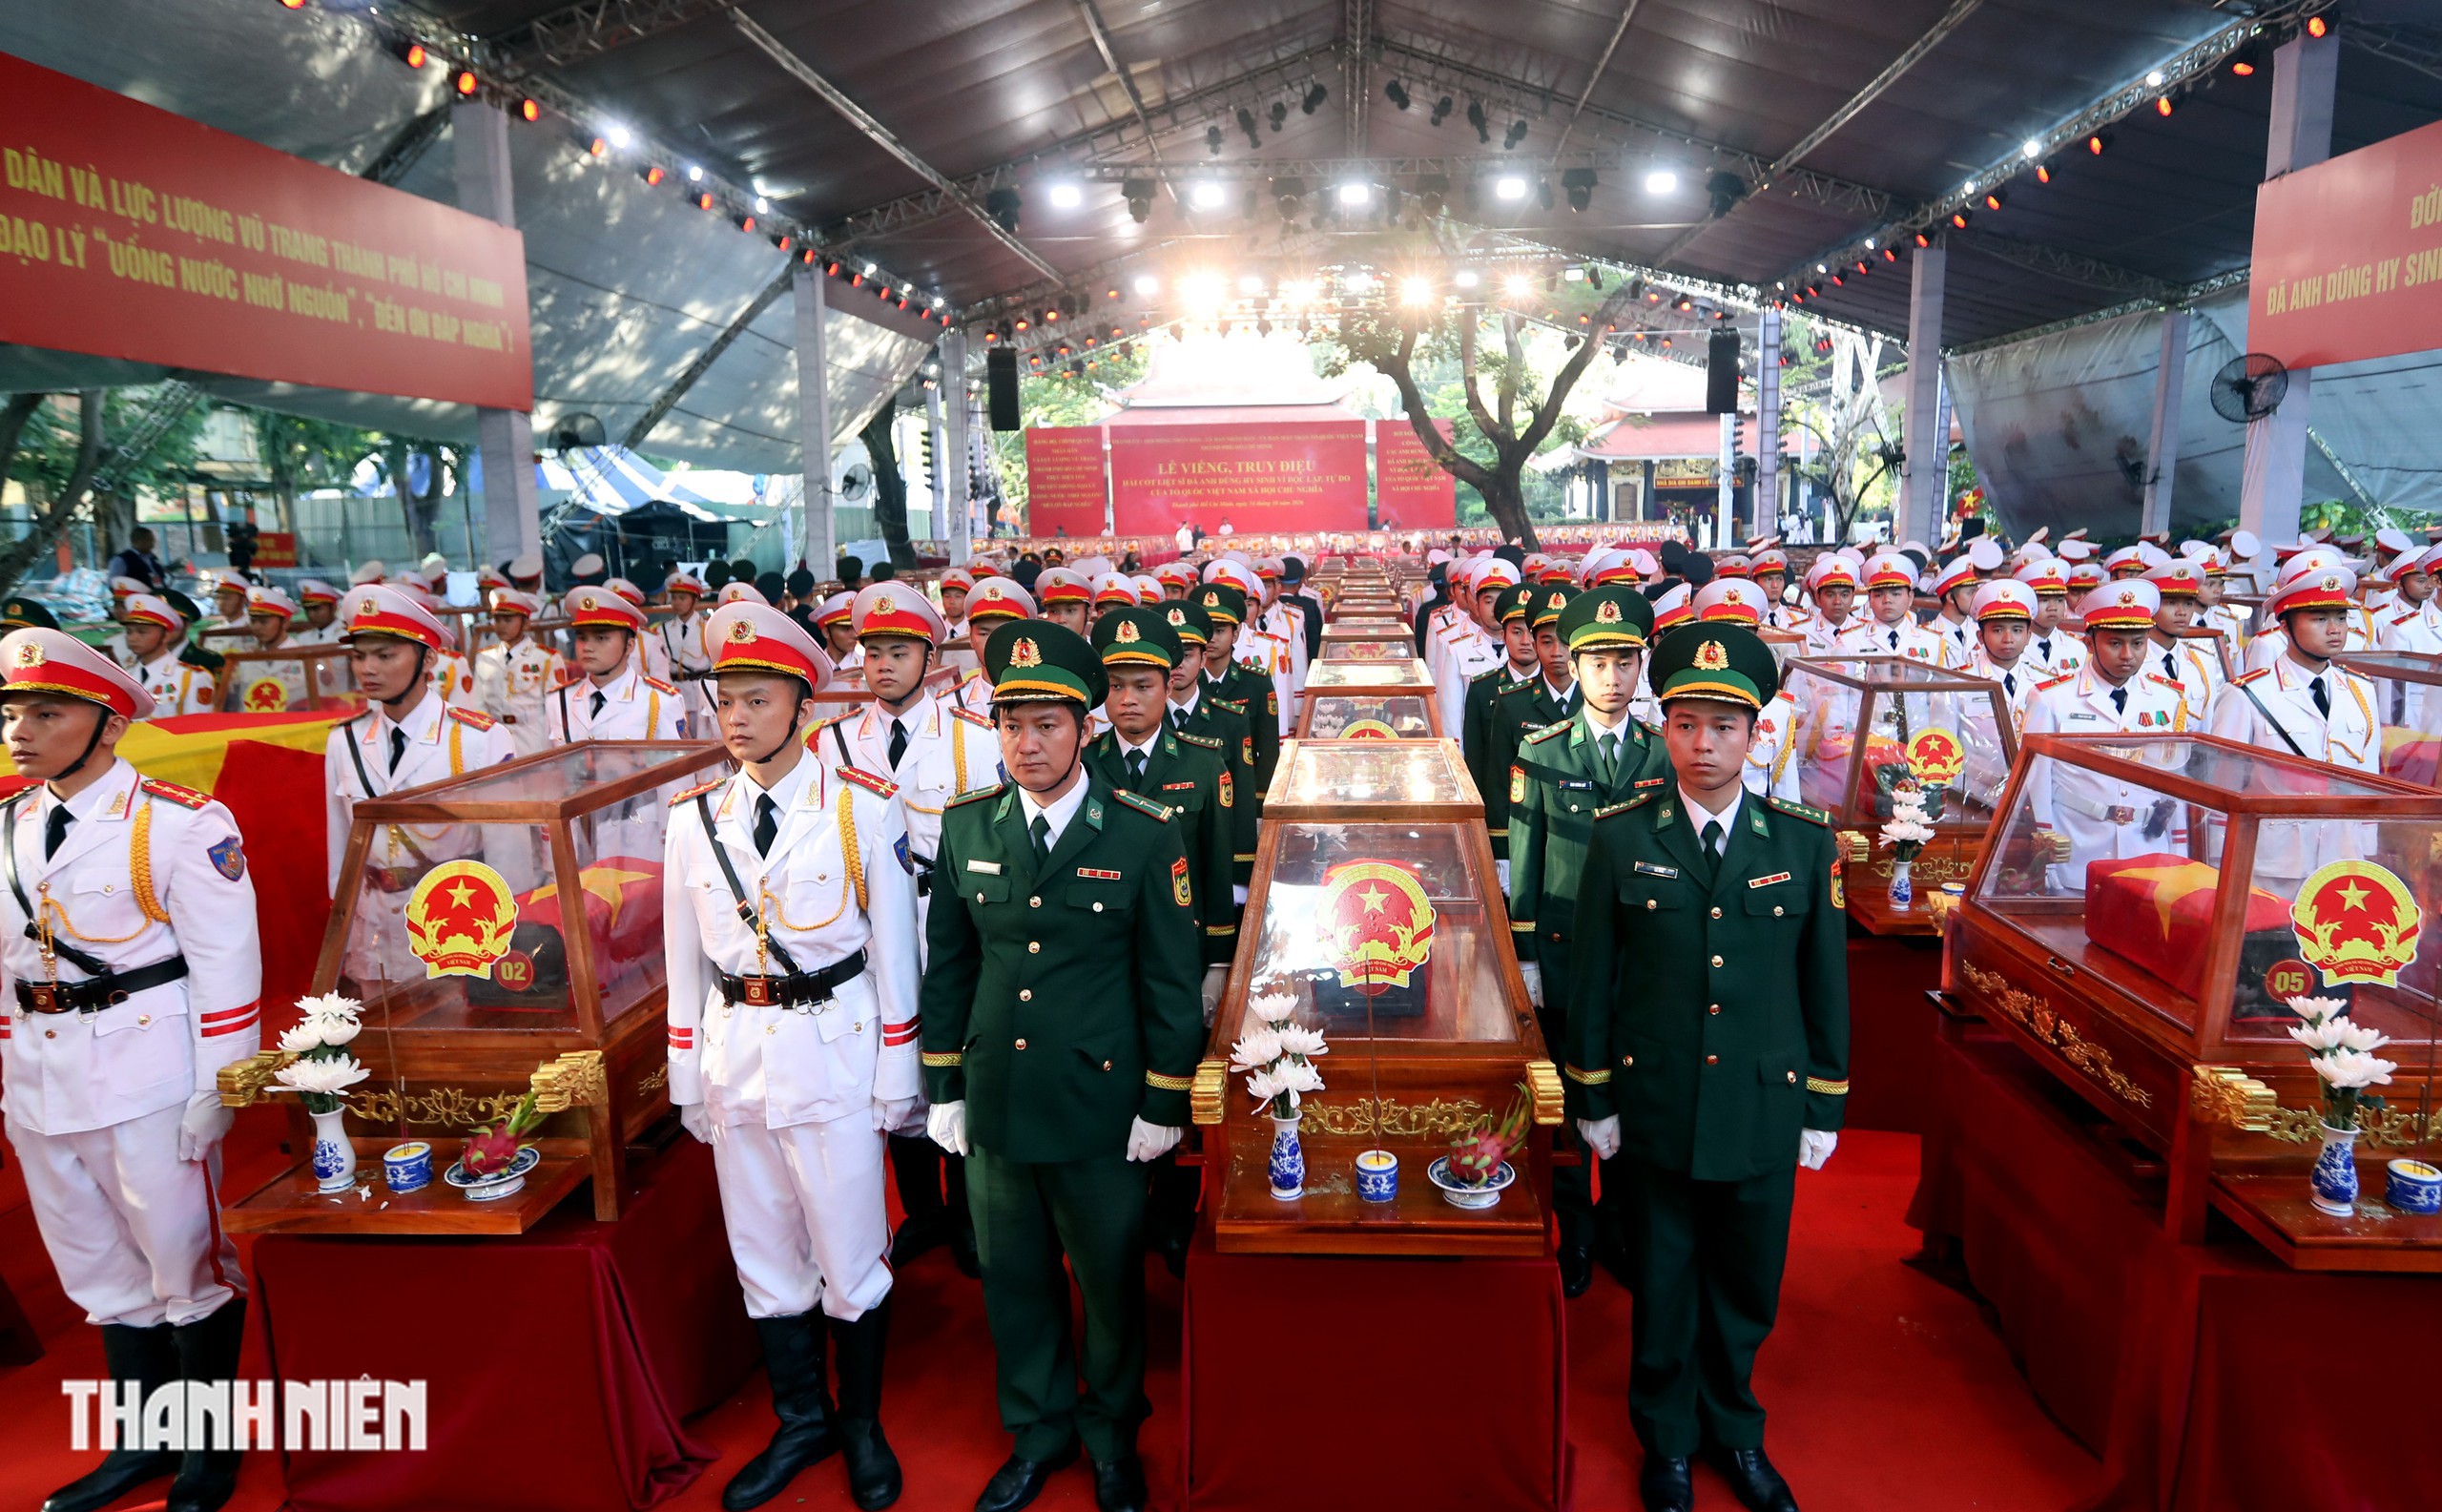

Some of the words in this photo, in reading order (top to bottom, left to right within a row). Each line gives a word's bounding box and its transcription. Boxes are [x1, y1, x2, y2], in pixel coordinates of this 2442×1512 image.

[4, 146, 66, 201] DÂN
[70, 163, 108, 212] VÀ
[110, 176, 157, 228] LỰC
[161, 193, 236, 244] LƯỢNG
[238, 213, 265, 253] VŨ
[268, 223, 329, 268] TRANG
[331, 239, 385, 282] THÀNH
[387, 252, 419, 289] PHỐ
[55, 223, 87, 269] LÝ
[179, 257, 238, 301] NƯỚC
[242, 271, 284, 311] NHỚ
[2266, 278, 2287, 317] ĐÃ
[2289, 275, 2322, 312] ANH
[2326, 264, 2372, 303] DŨNG
[2375, 258, 2401, 294] HY
[1158, 459, 1177, 474] LỄ
[1181, 459, 1231, 474] VIẾNG,
[1236, 460, 1276, 473] TRUY
[1279, 459, 1315, 475] ĐIỆU
[501, 962, 526, 981] 02
[2274, 971, 2305, 993] 05
